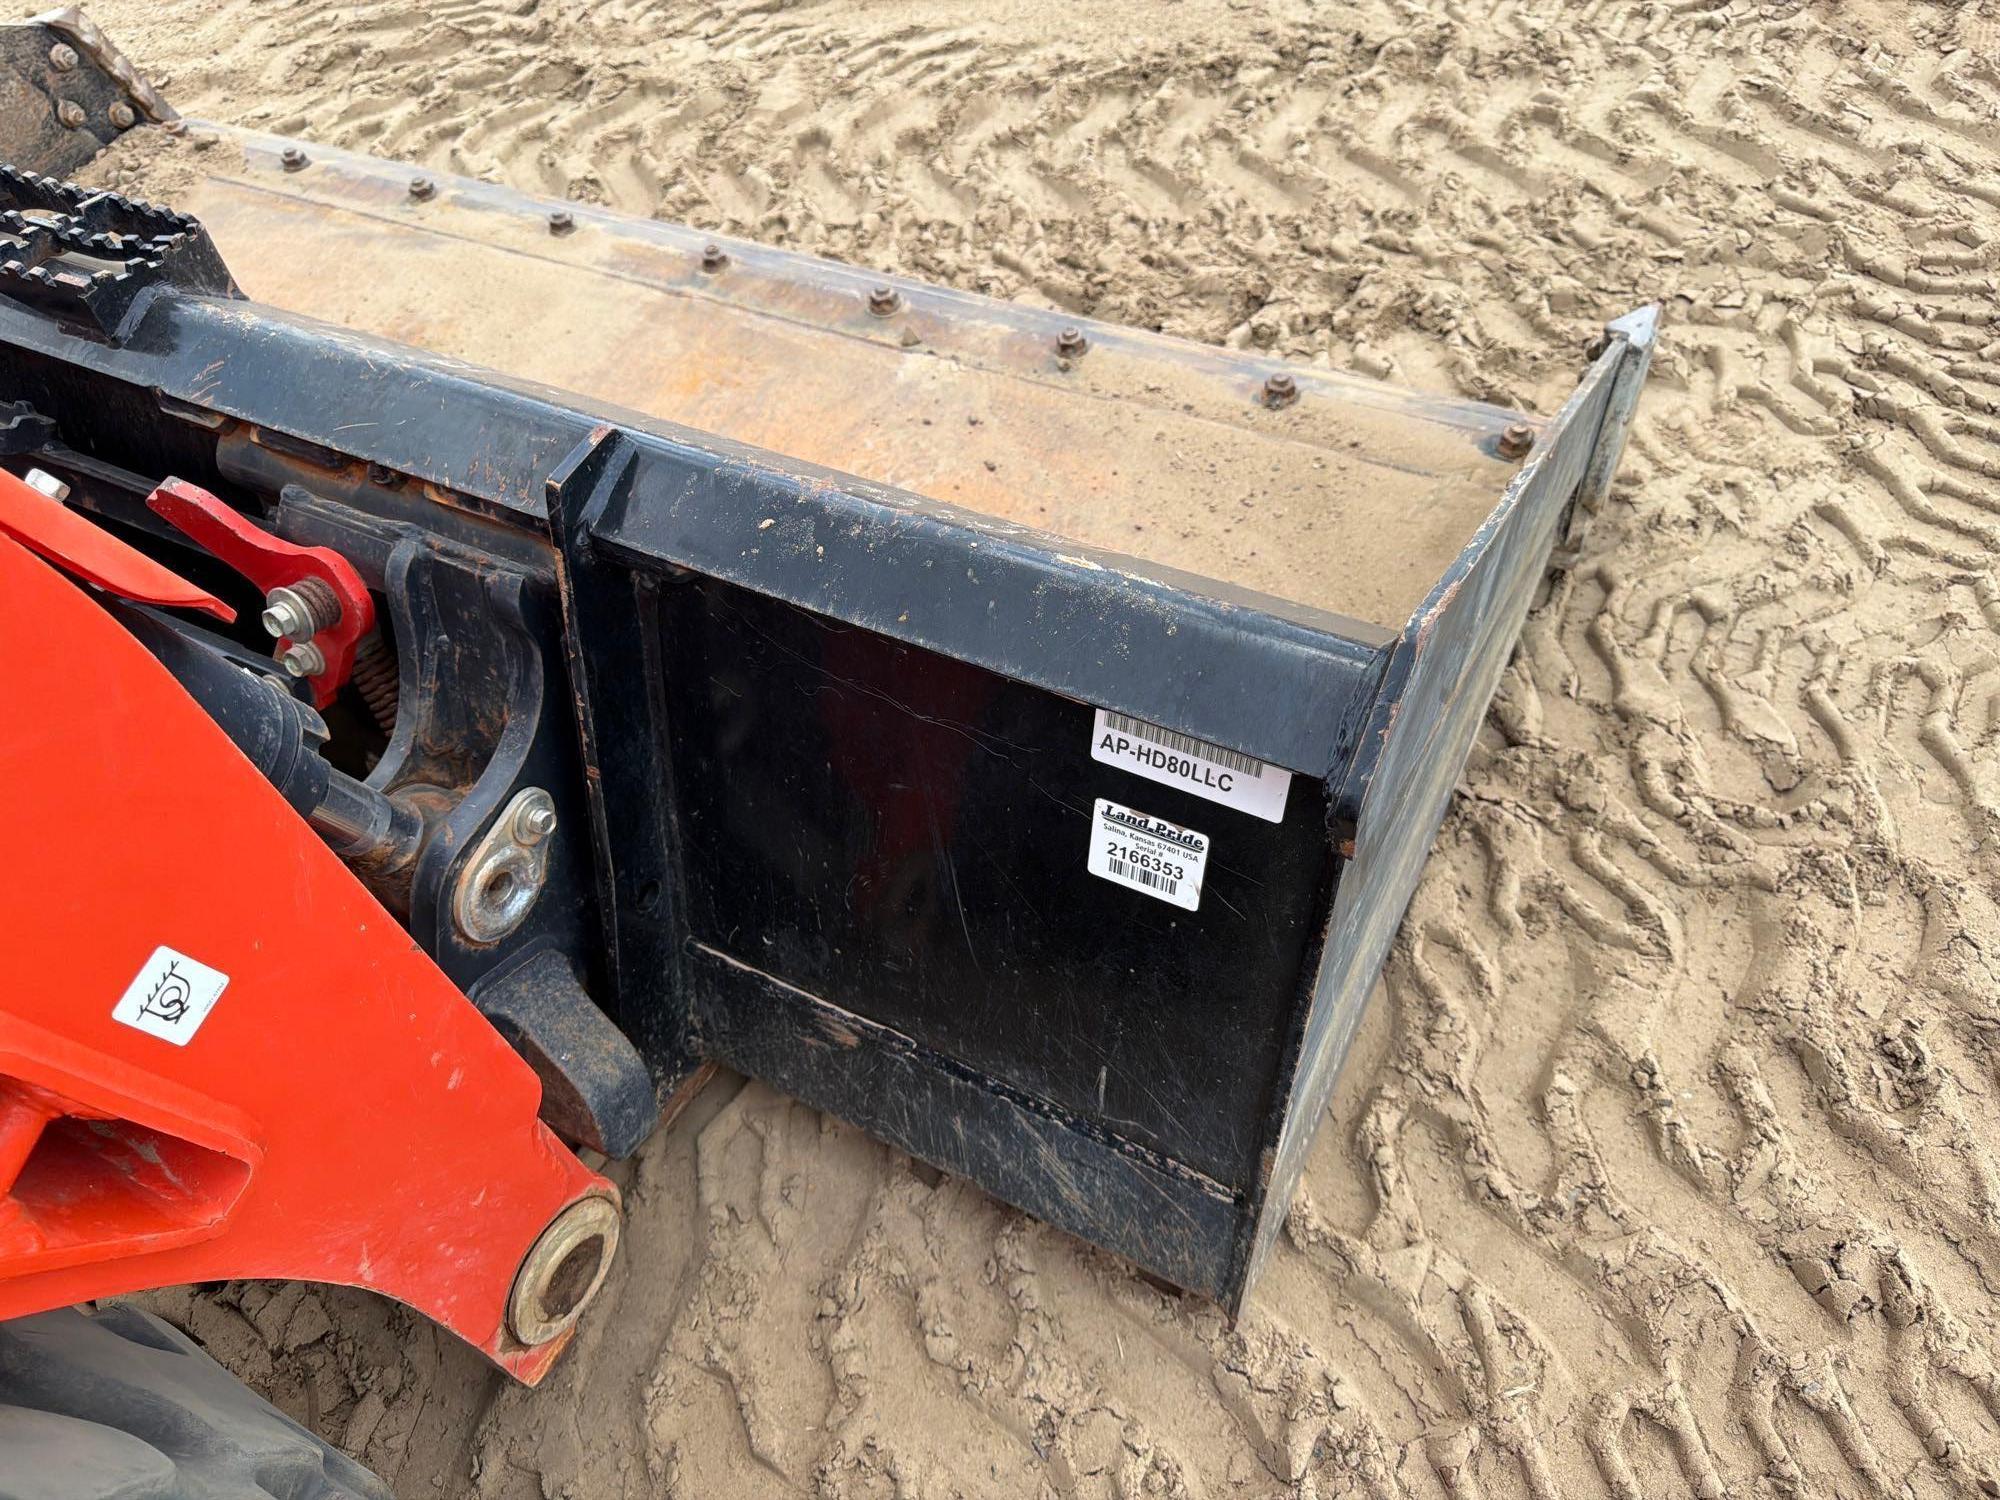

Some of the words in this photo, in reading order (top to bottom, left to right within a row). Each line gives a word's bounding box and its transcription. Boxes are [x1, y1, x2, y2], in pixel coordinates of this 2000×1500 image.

[1101, 804, 1151, 832] Land
[1151, 821, 1205, 852] Pride
[1103, 823, 1128, 838] Salina,
[1129, 832, 1155, 847] Kansas
[1157, 842, 1180, 856] 67401
[1182, 851, 1199, 863] USA
[1106, 841, 1184, 881] 2166353
[1135, 842, 1157, 855] Serial
